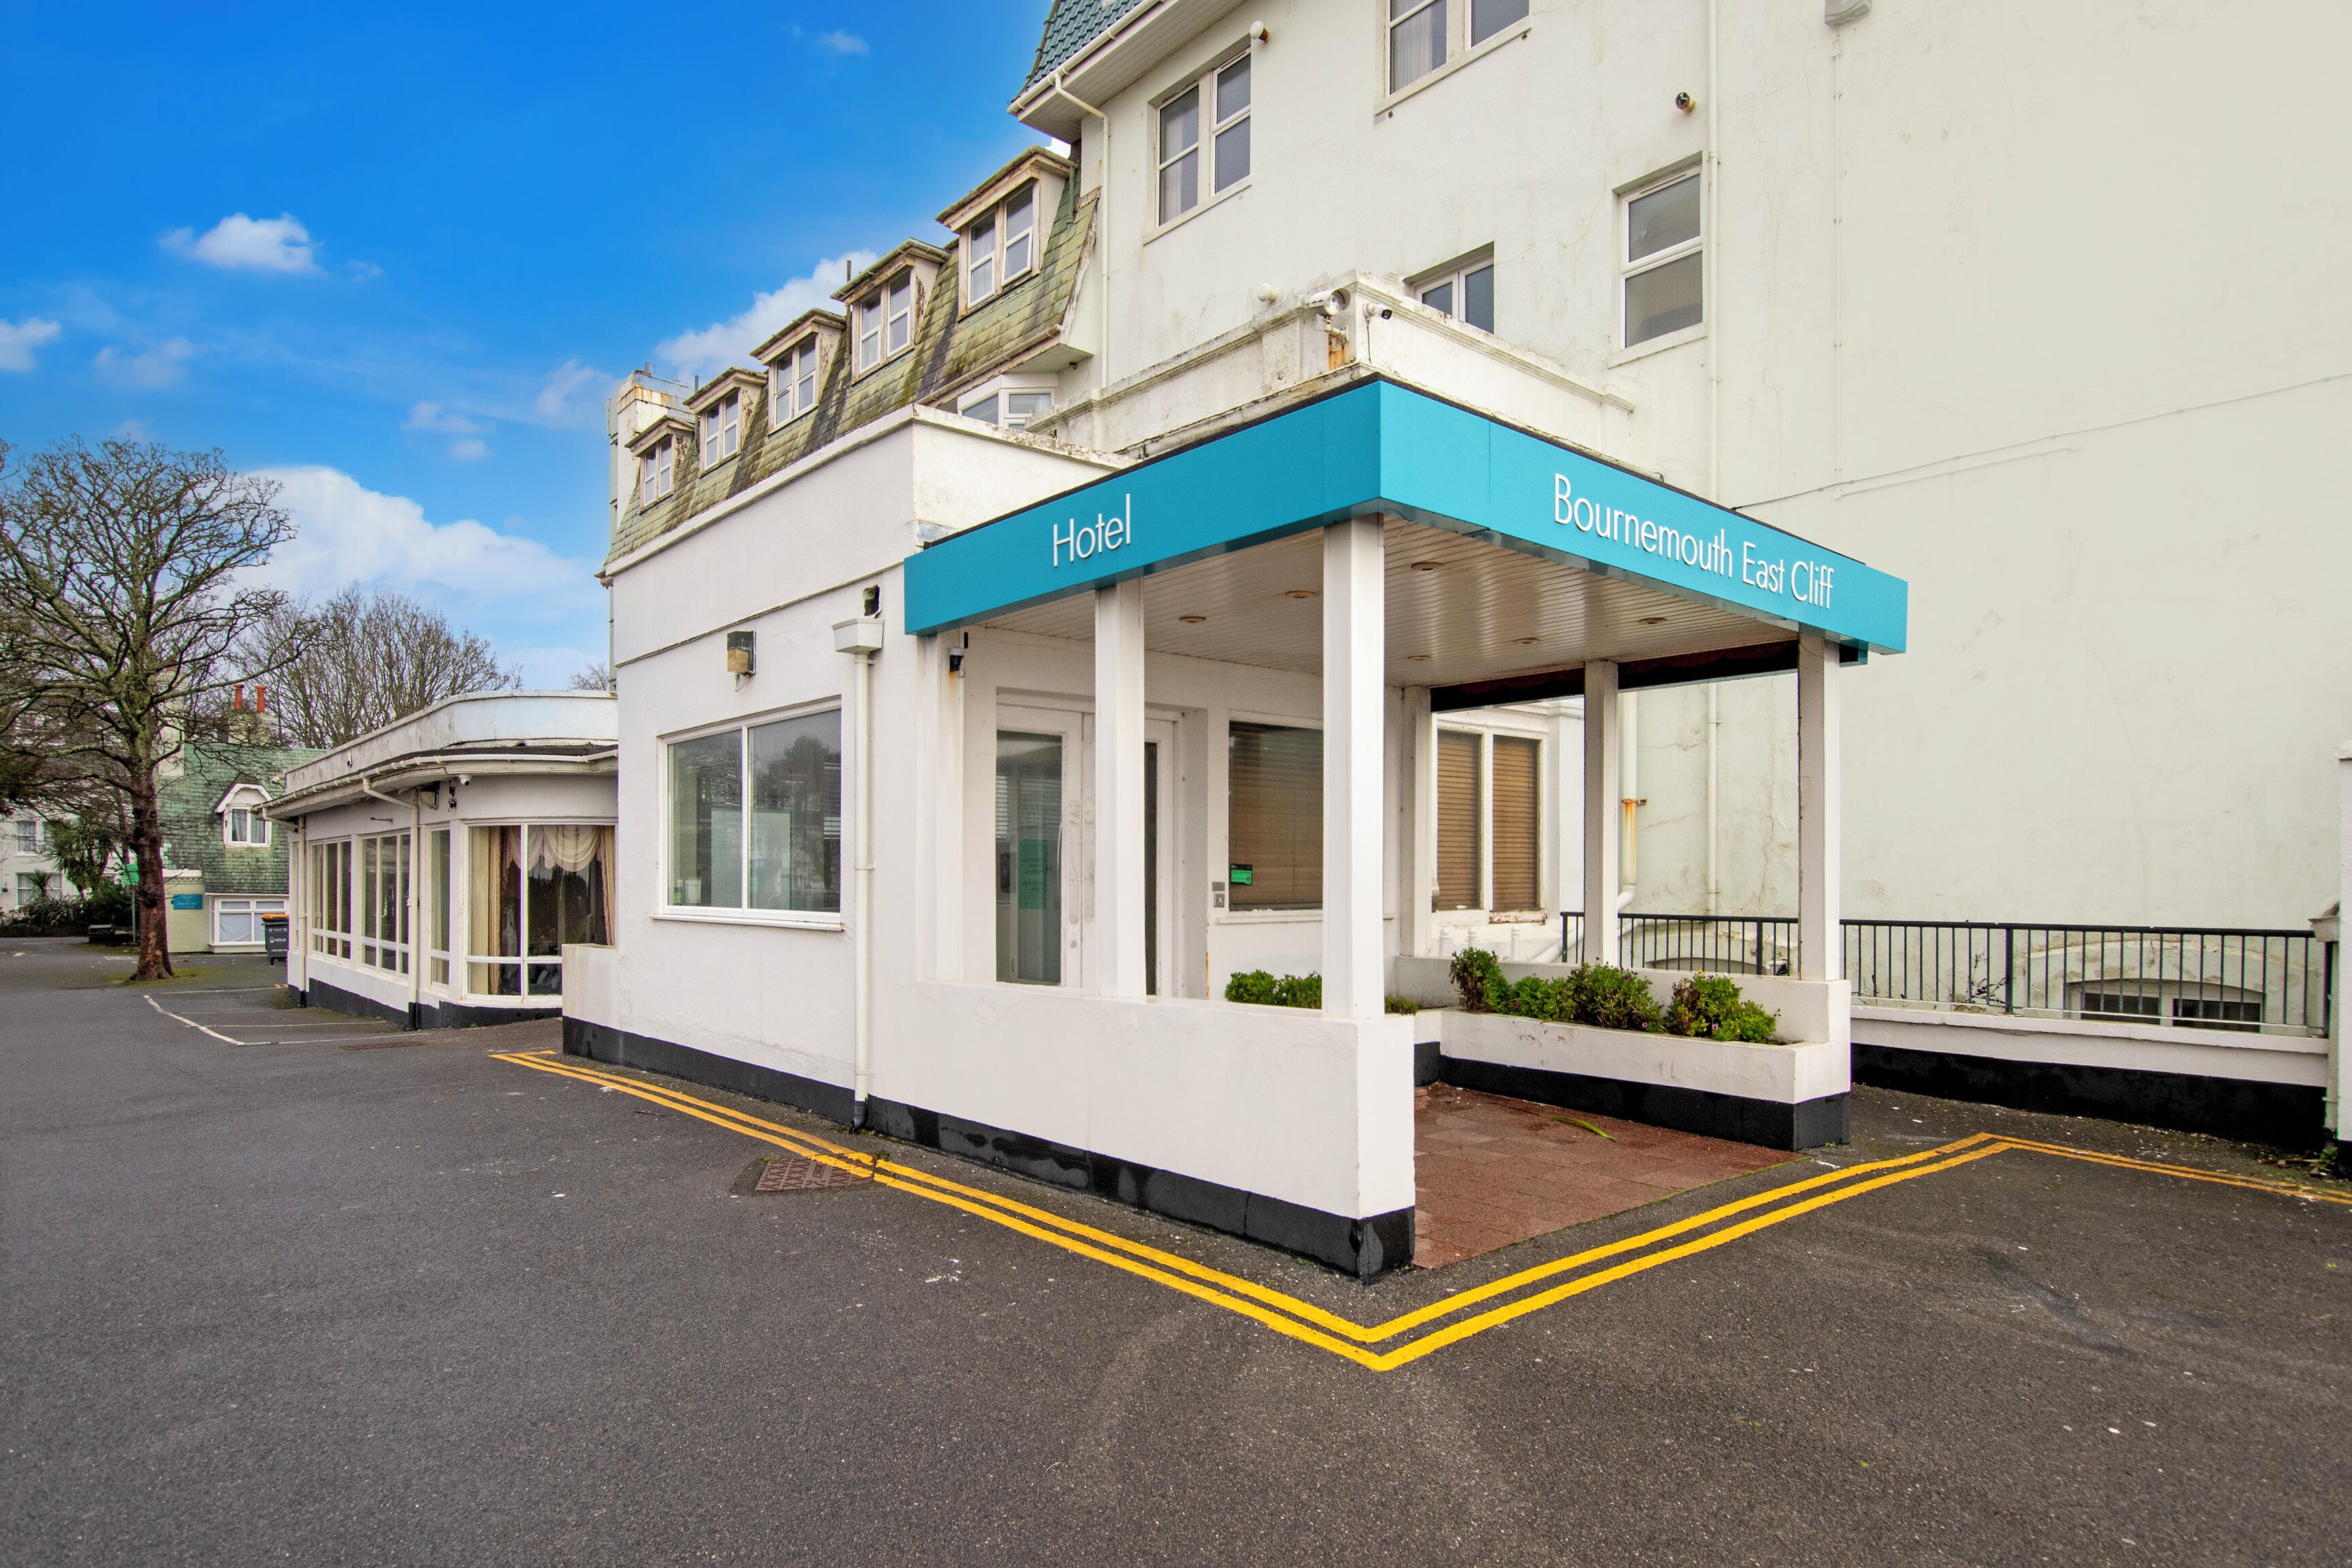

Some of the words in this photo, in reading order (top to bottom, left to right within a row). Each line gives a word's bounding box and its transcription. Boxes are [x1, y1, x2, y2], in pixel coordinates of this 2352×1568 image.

[1053, 493, 1130, 568] Hotel
[1554, 473, 1733, 578] Bournemouth
[1742, 541, 1784, 595] East
[1791, 560, 1835, 609] Cliff
